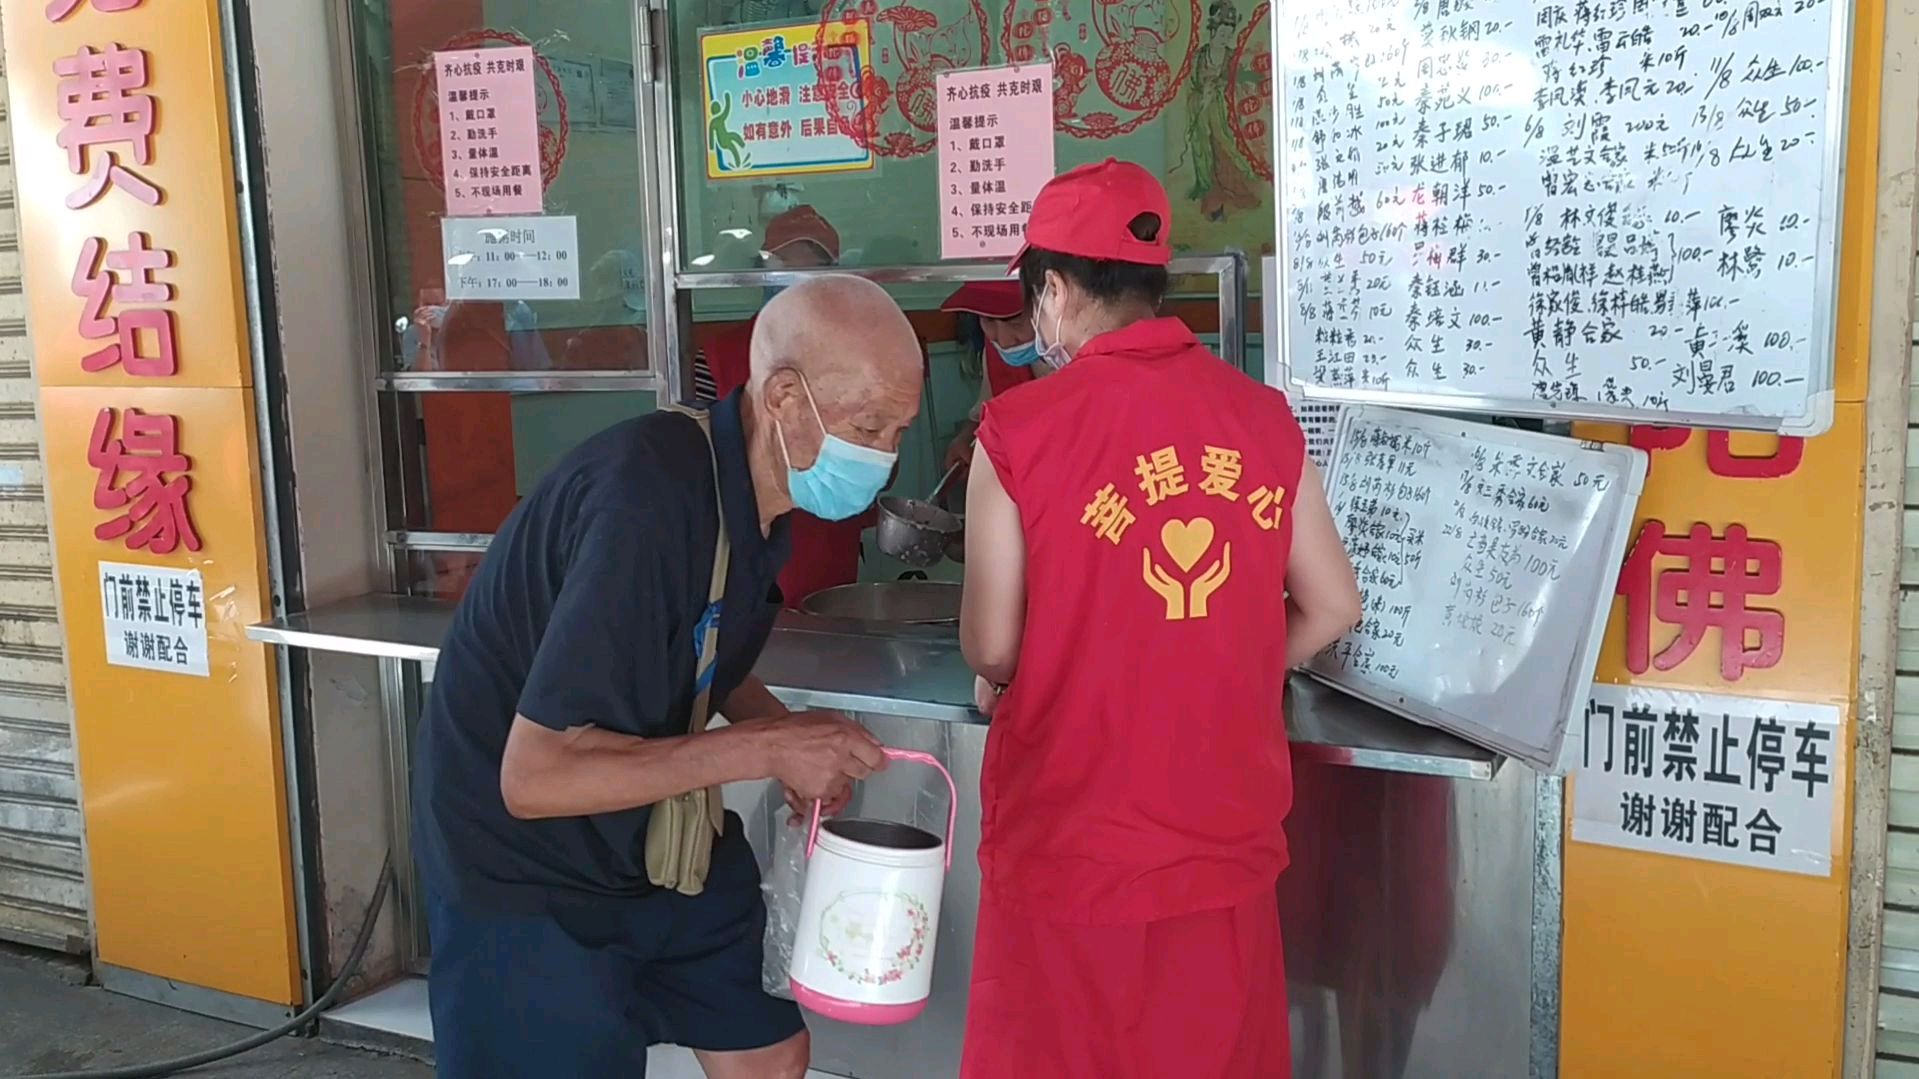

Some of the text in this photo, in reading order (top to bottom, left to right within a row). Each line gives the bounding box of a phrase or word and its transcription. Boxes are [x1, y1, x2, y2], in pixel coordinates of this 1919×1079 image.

[445, 58, 525, 77] 齐心抗疫 共克时艰
[448, 89, 489, 102] 温馨提示
[742, 86, 790, 108] 小心地滑
[947, 79, 1042, 102] 齐心抗疫 共克时艰
[743, 120, 792, 141] 如有意外
[949, 114, 998, 130] 温馨提示
[950, 136, 1005, 151] 1、戴口罩
[950, 157, 1006, 173] 2、勤洗手
[951, 180, 1006, 195] 3、量体温
[952, 223, 1027, 238] 5、不现场用
[45, 0, 202, 554] 费结缘
[1080, 445, 1285, 545] 菩提爱心
[104, 572, 202, 628] 门前禁止停车
[124, 630, 188, 665] 谢谢配合
[1583, 699, 1832, 798] 门前禁止停车
[1620, 791, 1783, 856] 谢谢配合
